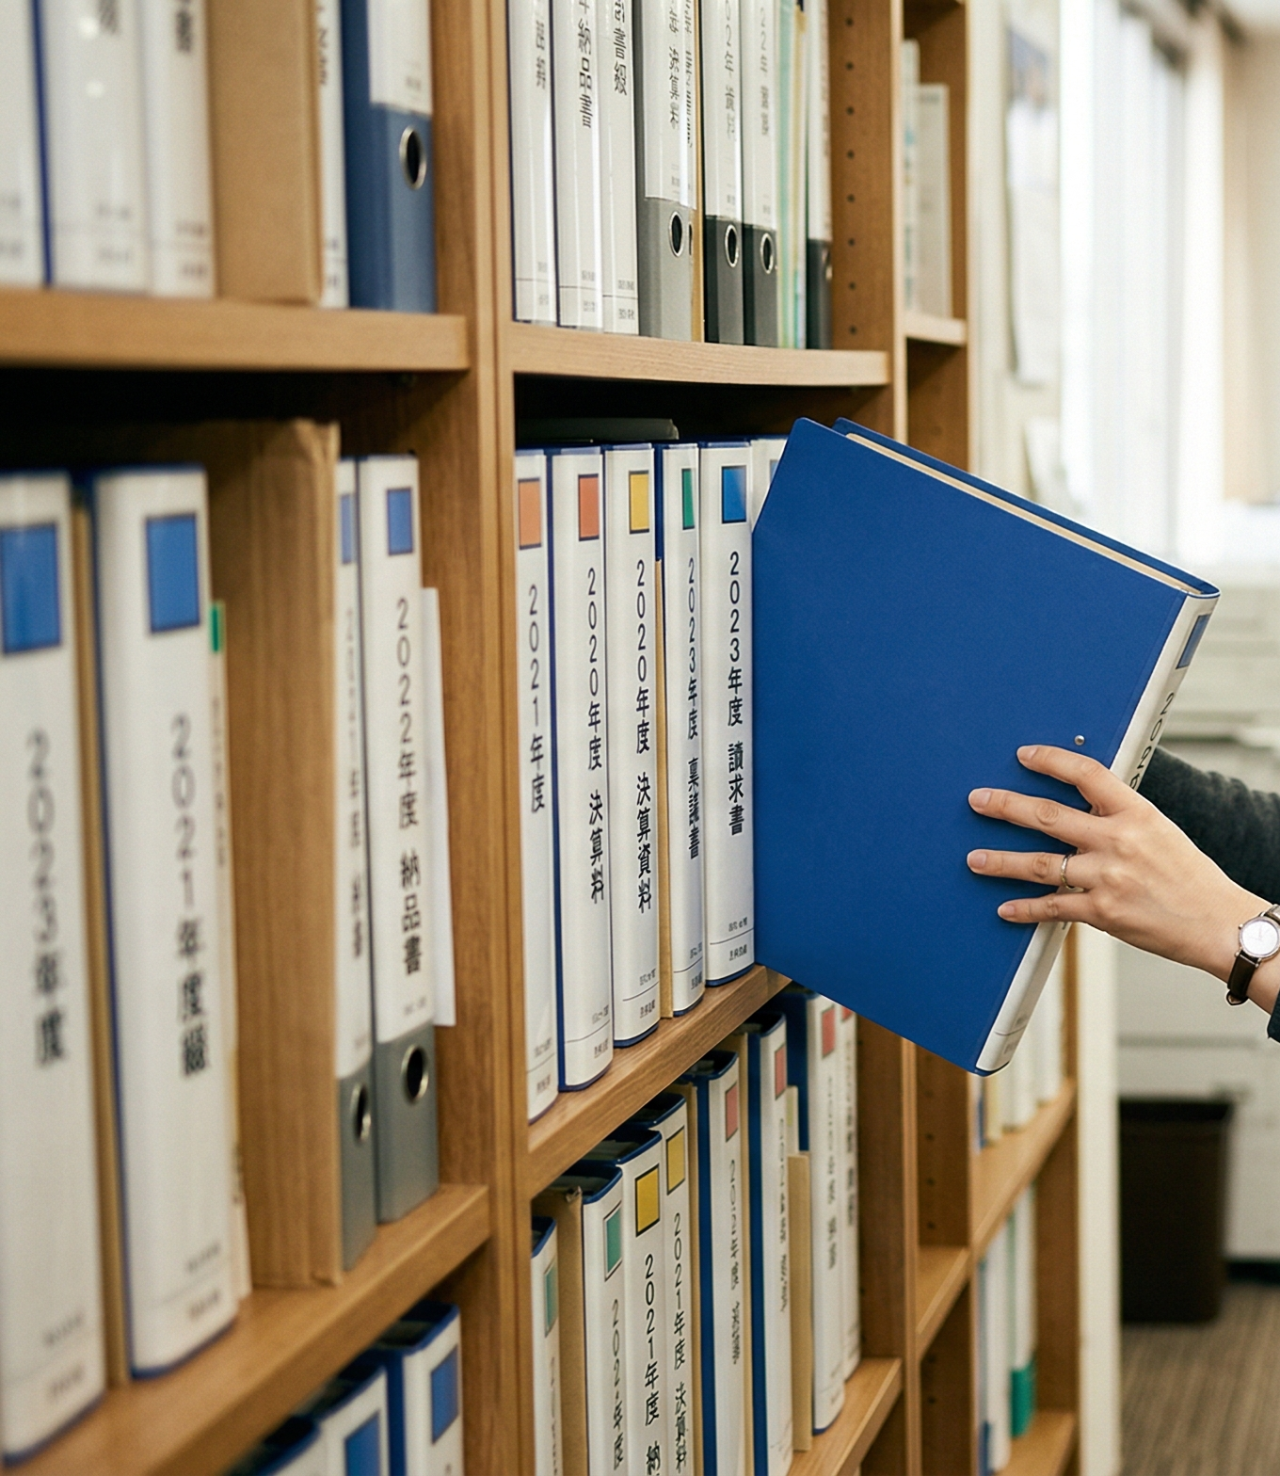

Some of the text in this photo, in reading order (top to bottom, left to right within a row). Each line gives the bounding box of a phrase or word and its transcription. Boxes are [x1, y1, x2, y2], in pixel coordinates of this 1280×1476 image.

[397, 597, 419, 831] 2022年度
[529, 584, 545, 815] 2021年度
[587, 567, 603, 771] 2020年度
[636, 559, 651, 754] 2020年度
[687, 557, 699, 741] 2023年度
[728, 551, 743, 728] 2023年度
[644, 1254, 660, 1426] 2021年度
